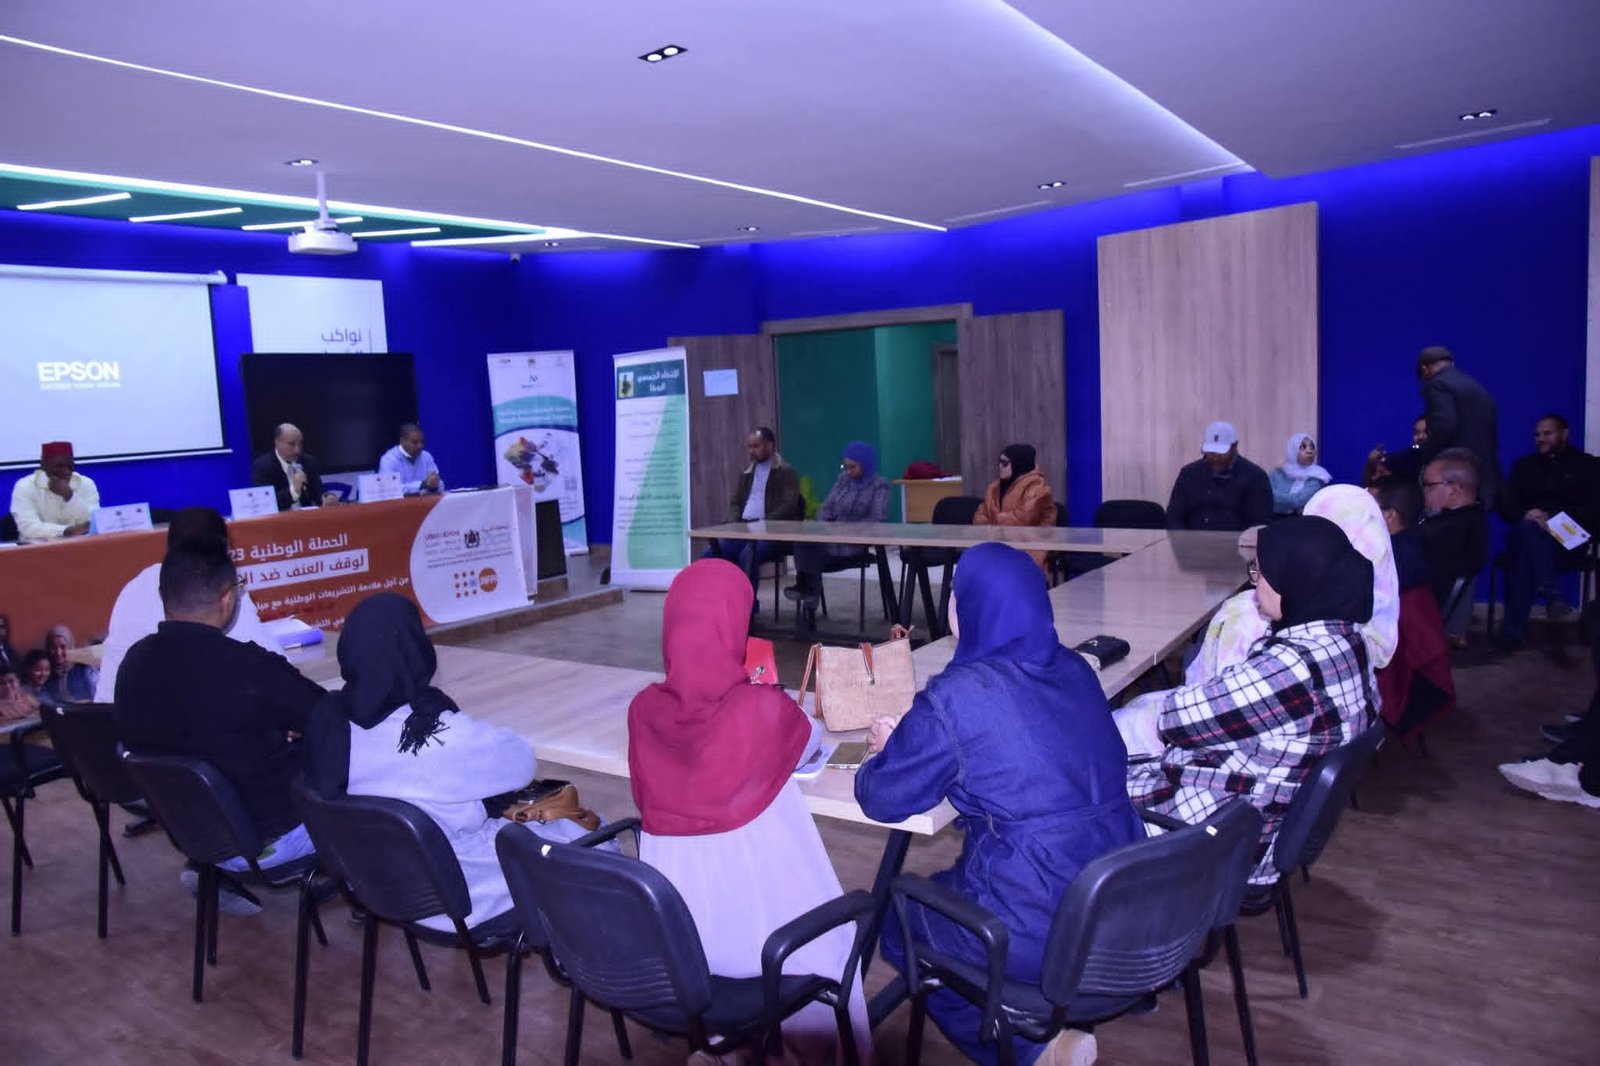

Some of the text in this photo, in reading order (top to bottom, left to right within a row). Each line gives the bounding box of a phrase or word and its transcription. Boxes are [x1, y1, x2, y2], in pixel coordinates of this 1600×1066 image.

[37, 360, 120, 382] EPSON
[250, 538, 304, 562] الوطنية
[308, 532, 348, 551] الحملة
[286, 561, 324, 578] العنف
[329, 554, 364, 571] لوقف
[260, 568, 281, 582] ضد
